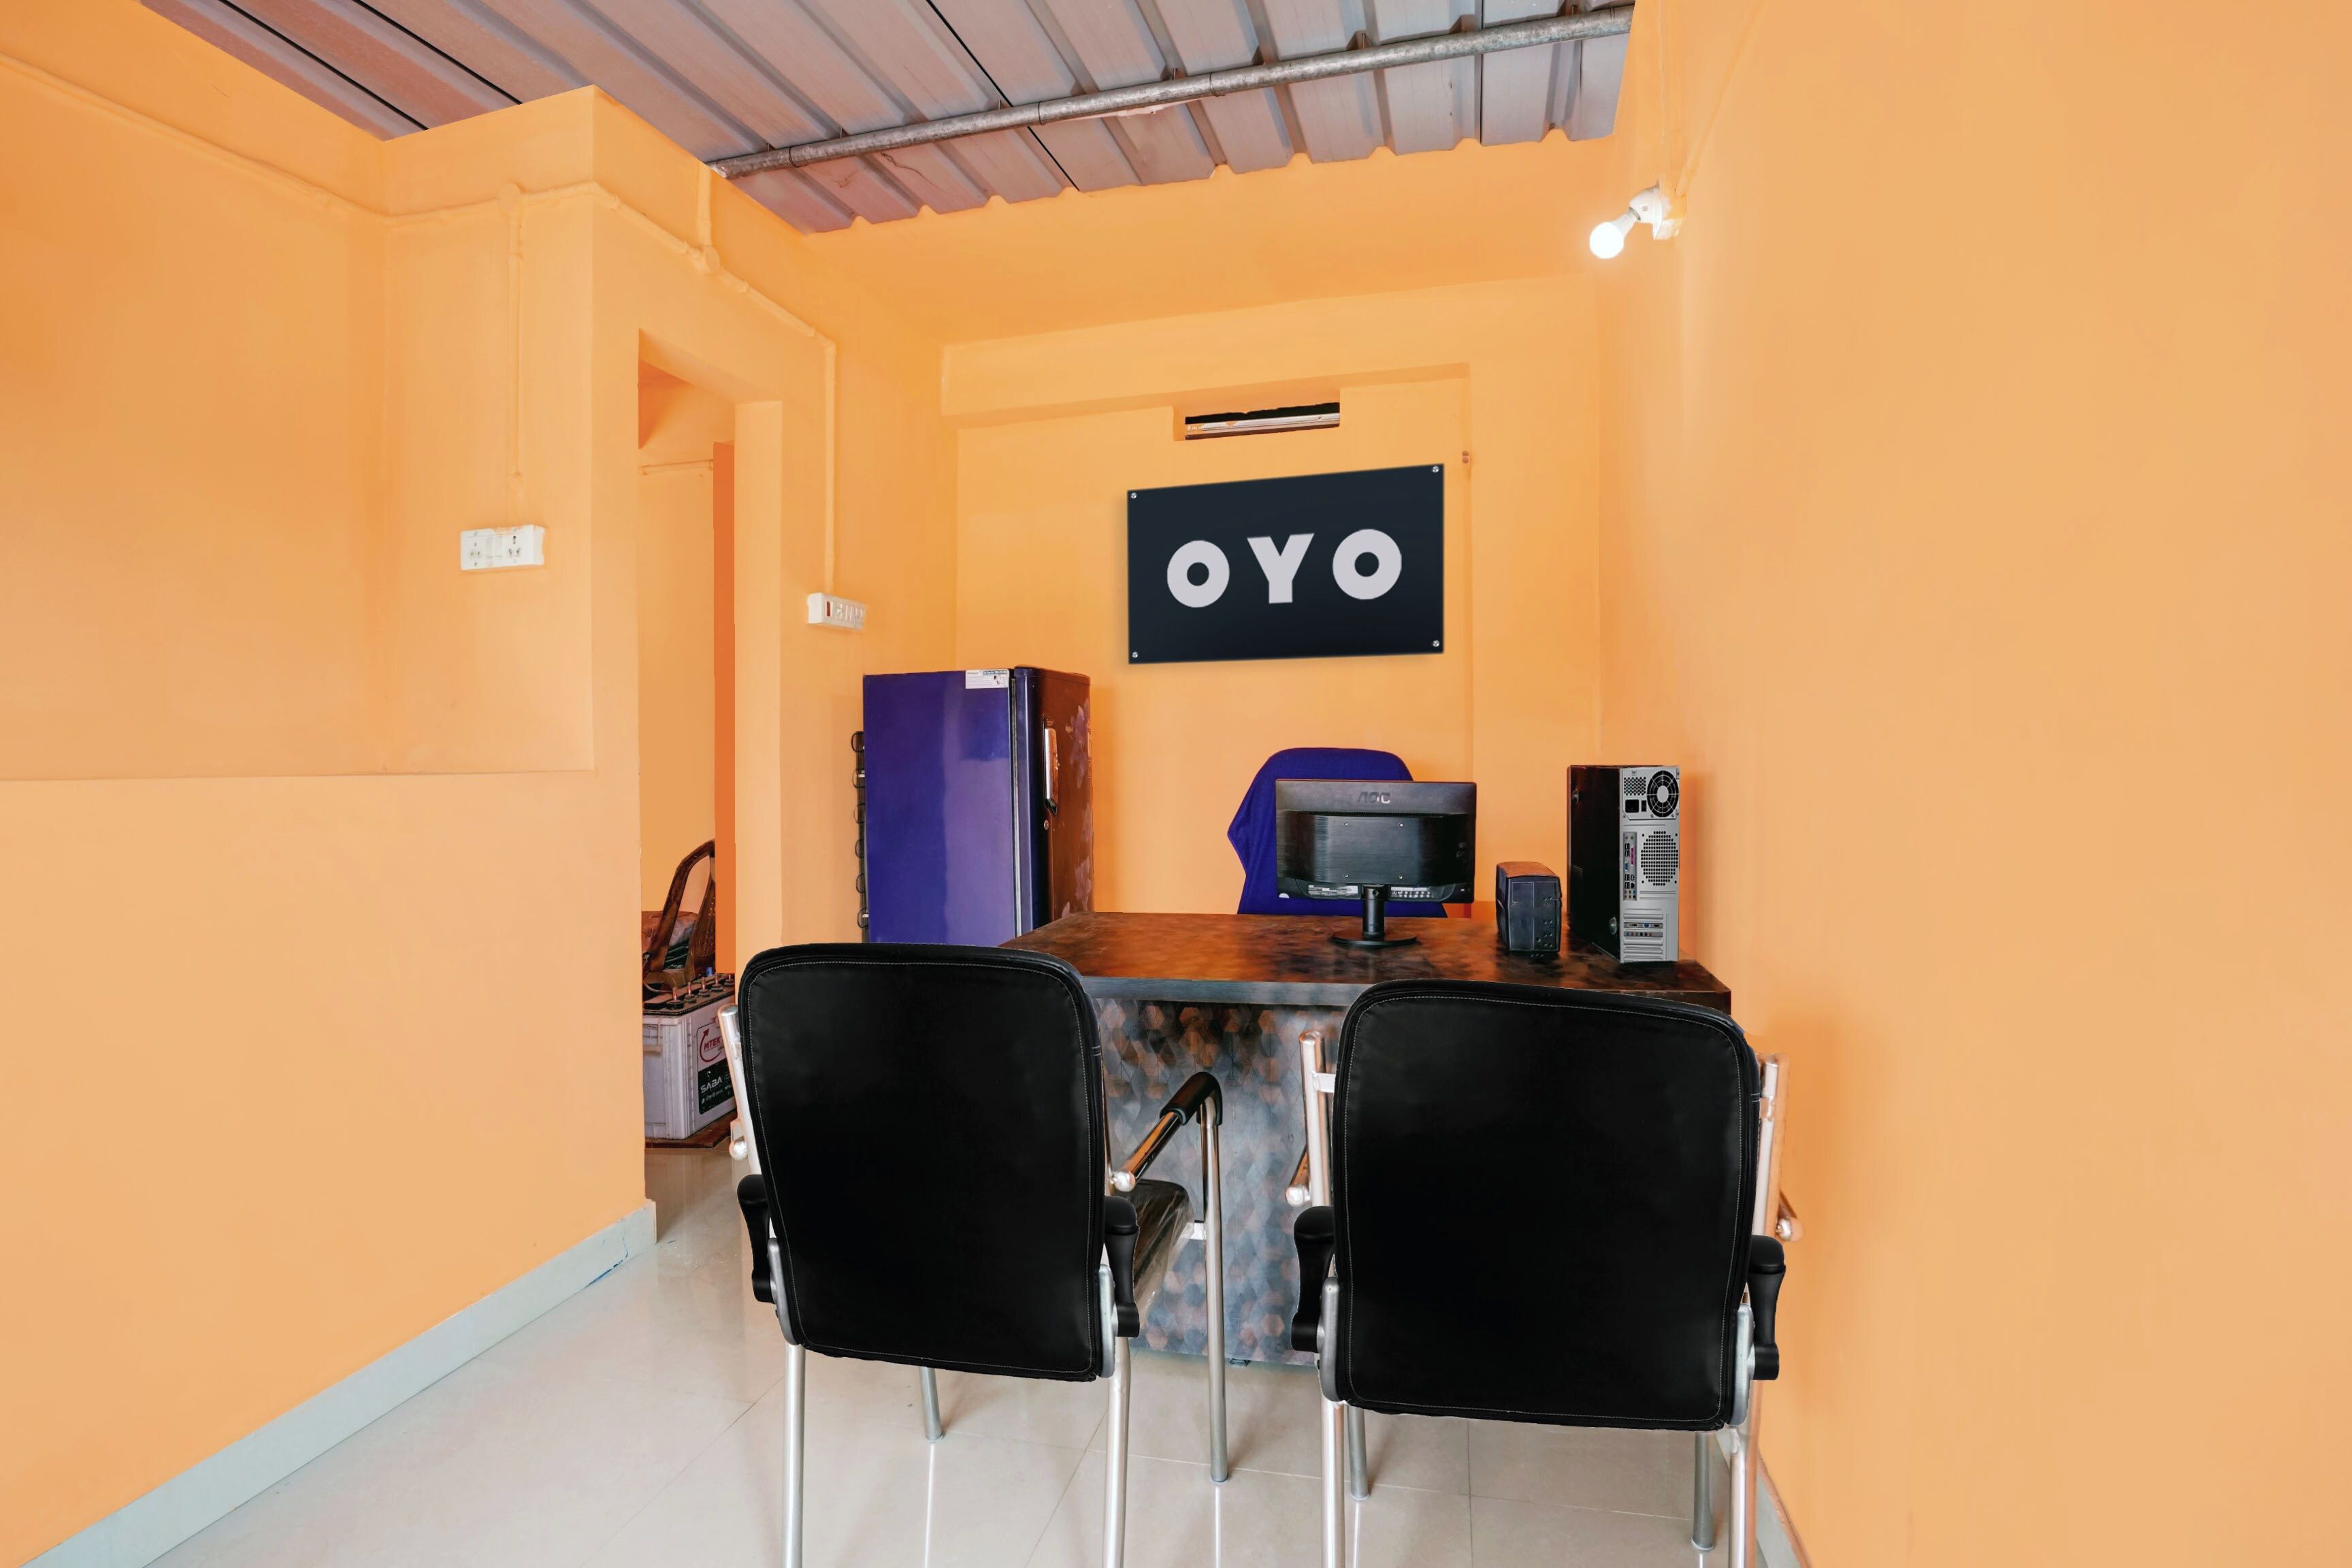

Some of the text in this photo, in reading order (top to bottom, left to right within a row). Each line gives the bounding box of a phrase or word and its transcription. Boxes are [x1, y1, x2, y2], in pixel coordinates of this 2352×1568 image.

[1166, 528, 1403, 608] OYO
[1356, 791, 1390, 804] AOC
[700, 1076, 722, 1094] SABA
